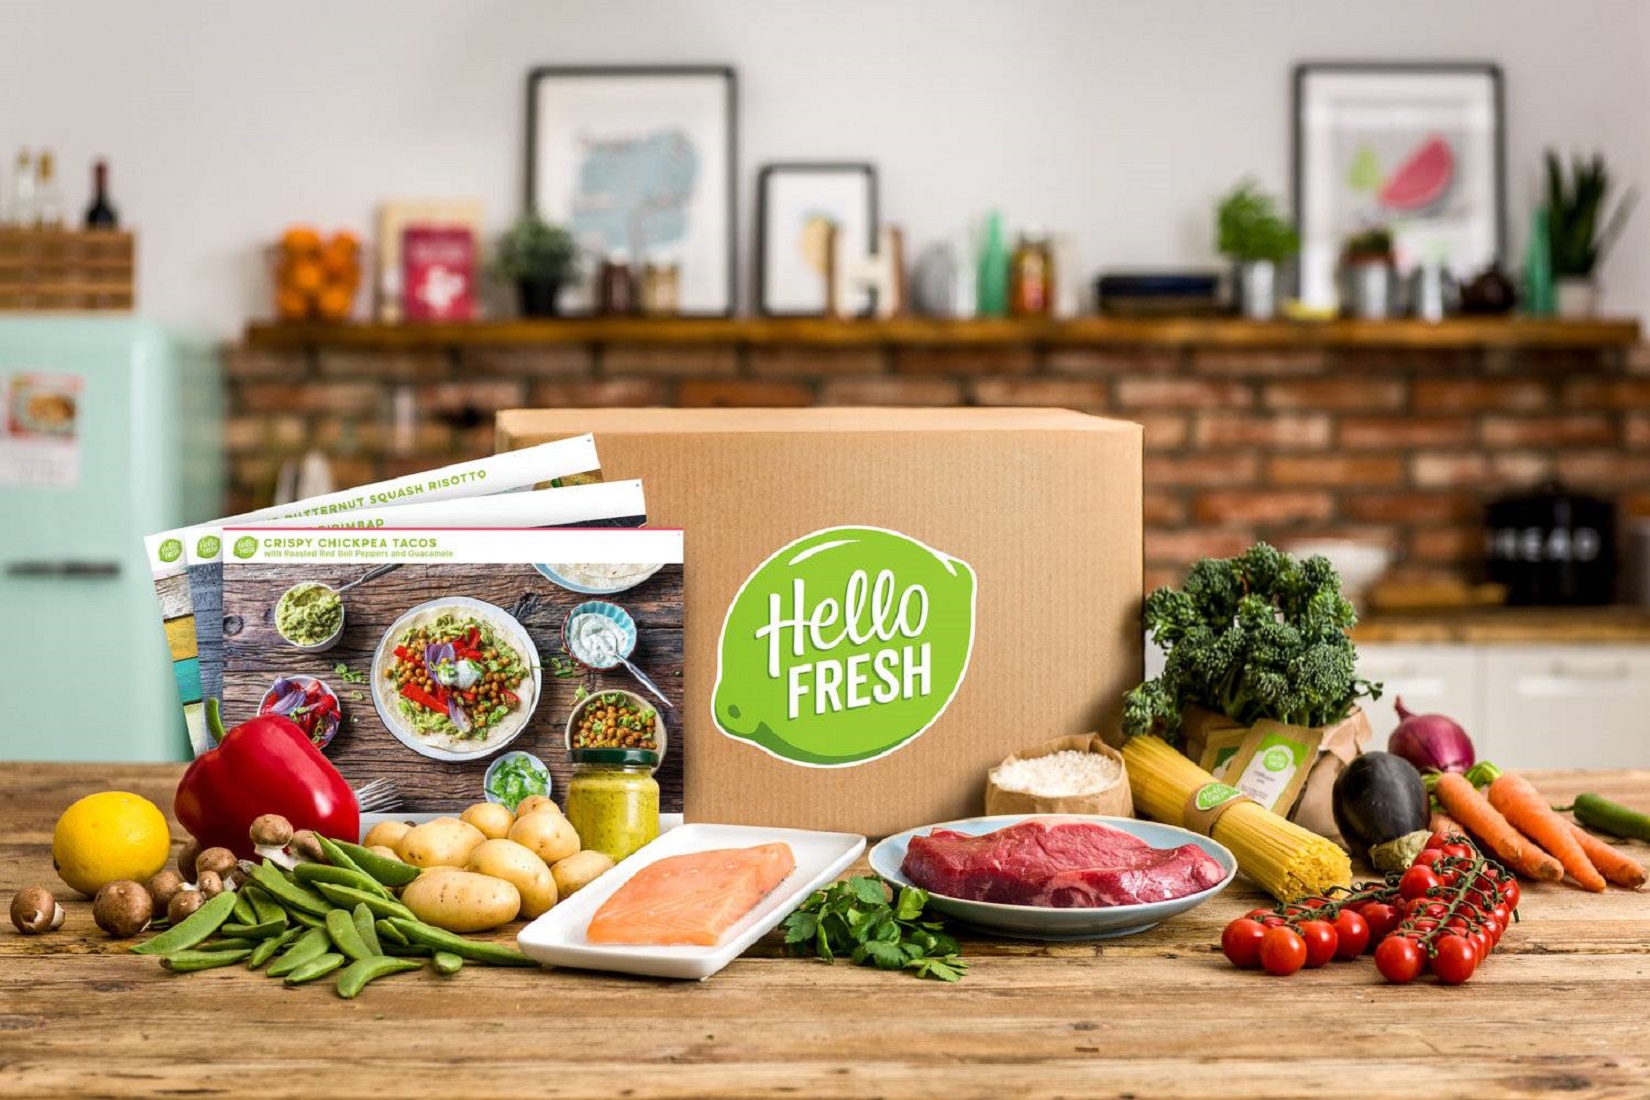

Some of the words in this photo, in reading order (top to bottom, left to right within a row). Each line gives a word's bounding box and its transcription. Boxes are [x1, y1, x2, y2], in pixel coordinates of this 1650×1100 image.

[369, 483, 424, 505] SQUASH
[428, 470, 487, 491] RISOTTO
[263, 538, 313, 548] CRISPY
[318, 538, 388, 548] CHICKPEA
[392, 538, 437, 548] TACOS
[264, 549, 281, 558] with
[284, 549, 317, 558] Roasted
[320, 549, 335, 558] Red
[355, 549, 388, 559] Peppers
[391, 549, 406, 558] and
[408, 549, 454, 558] Guacamole
[755, 569, 929, 678] Hello
[788, 642, 932, 719] FRESH
